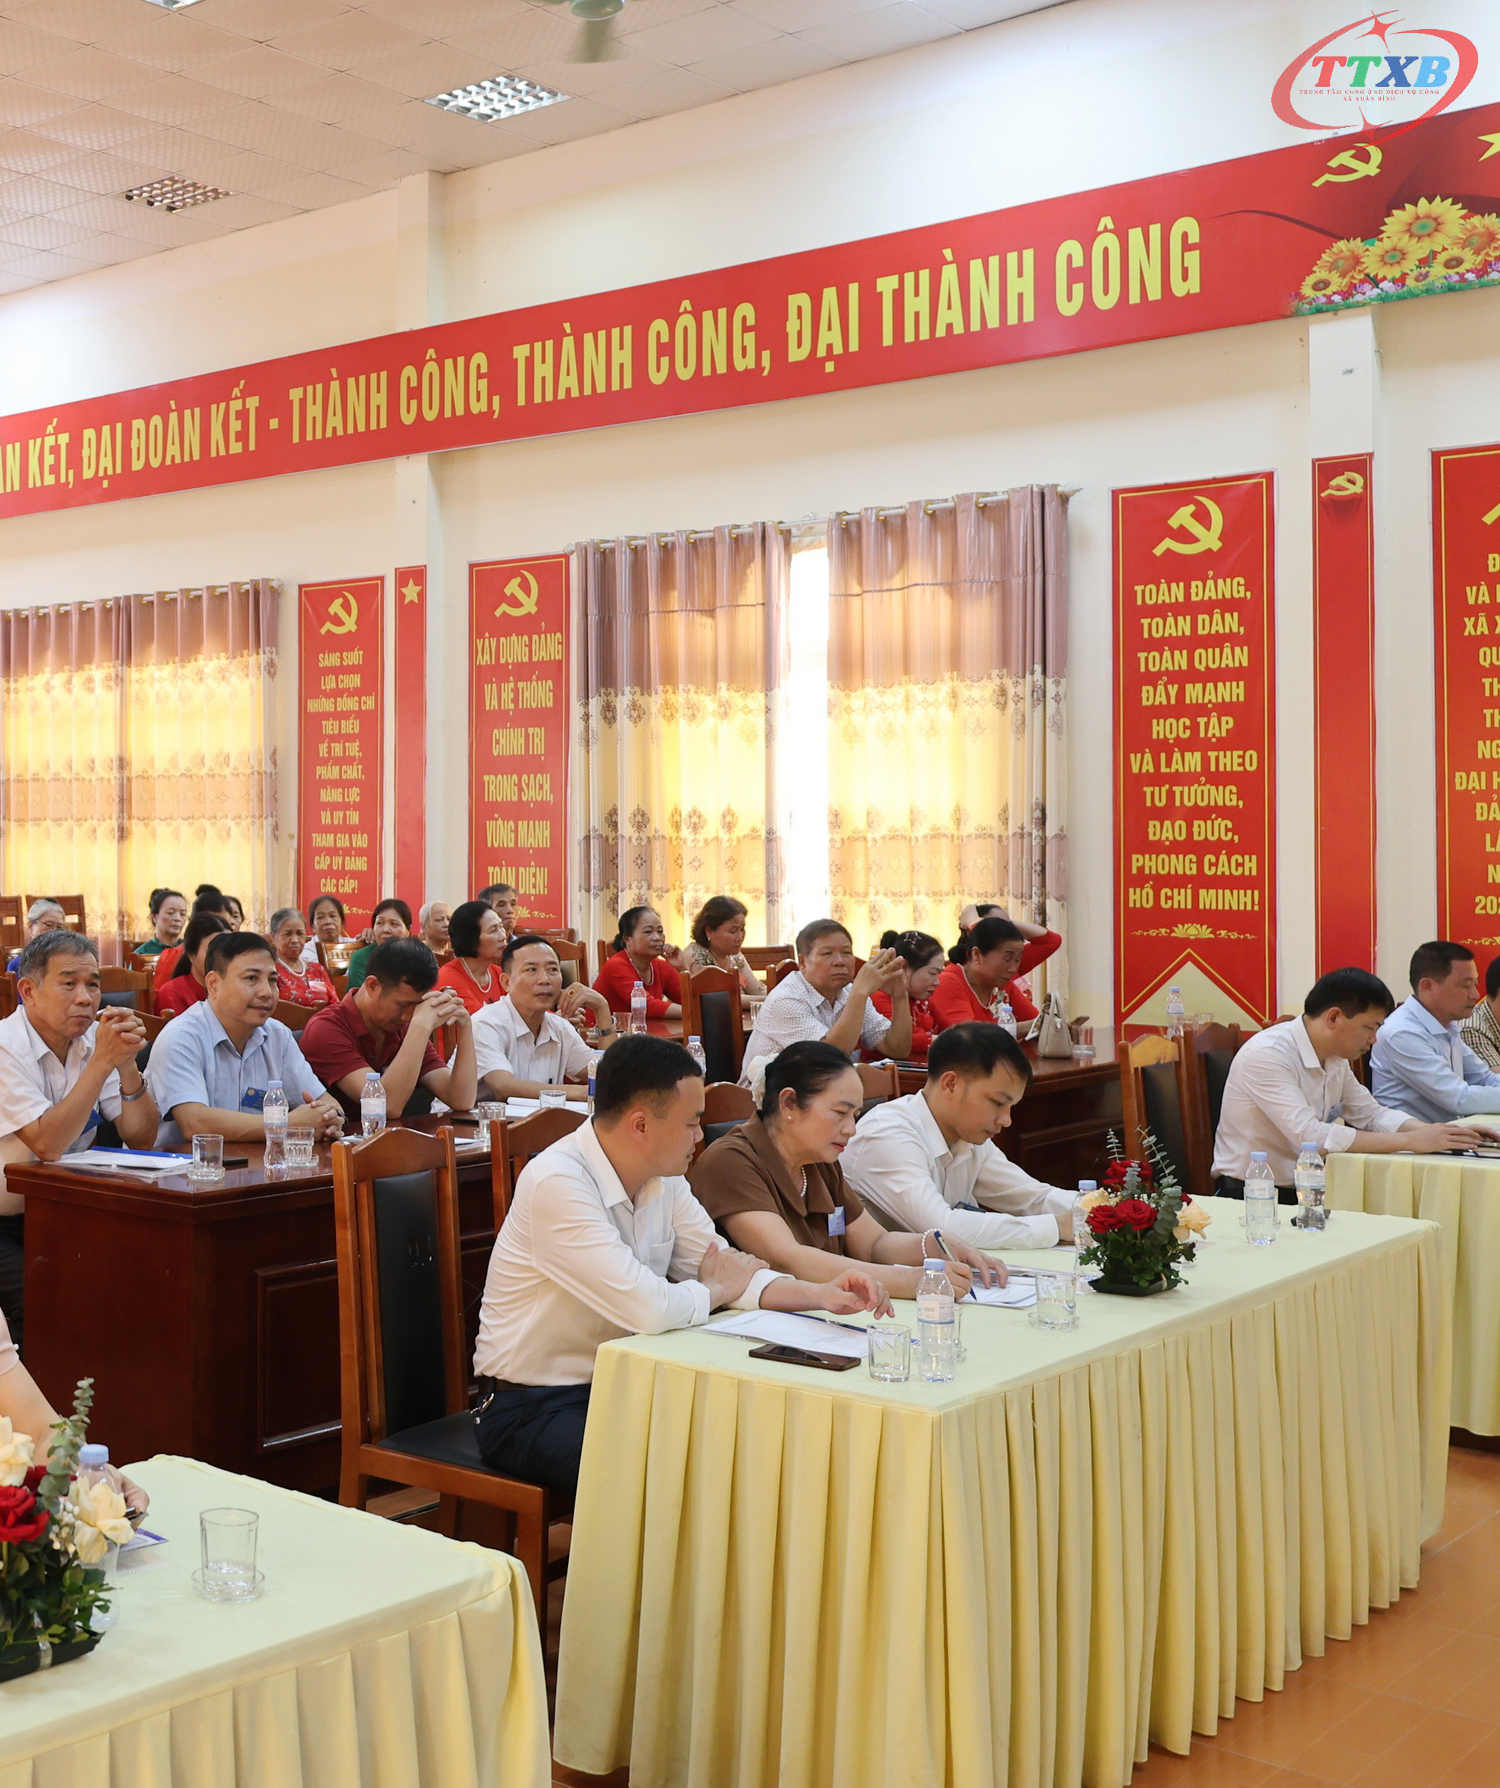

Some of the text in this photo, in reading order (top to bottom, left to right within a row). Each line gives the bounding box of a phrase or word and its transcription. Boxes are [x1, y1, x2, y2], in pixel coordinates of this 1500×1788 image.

[28, 417, 75, 489] KẾT,
[81, 422, 122, 489] ĐẠI
[130, 400, 201, 472] ĐOÀN
[210, 379, 260, 458] KẾT
[288, 367, 388, 444] THÀNH
[399, 348, 500, 426] CÔNG,
[512, 322, 633, 407] THÀNH
[647, 298, 771, 386] CÔNG,
[785, 281, 860, 374] ĐẠI
[875, 247, 1035, 347] THÀNH
[1055, 215, 1201, 318] CÔNG
[1134, 570, 1251, 605] TOÀN ĐẢNG,
[1465, 581, 1491, 605] VÀ
[1141, 608, 1245, 638] TOÀN DÂN,
[1463, 612, 1489, 636] XÃ
[318, 645, 364, 668] SÁNG SUỐT
[476, 621, 562, 669] XÂY DỰNG ĐẢNG
[1137, 642, 1249, 673] TOÀN QUÂN
[321, 673, 361, 692] LỰA CHỌN
[484, 670, 553, 716] VÀ HỆ THỐNG
[1141, 676, 1245, 708] ĐẨY MẠNH
[307, 694, 335, 712] NHỮNG
[360, 692, 375, 711] CHÍ
[321, 713, 359, 735] TIÊU BIỂU
[1152, 712, 1234, 743] HỌC TẬP
[330, 739, 343, 757] TRÍ
[345, 739, 362, 759] TUỆ,
[492, 722, 545, 761] CHÍNH TRỊ
[316, 759, 365, 780] PHẨM CHẤT,
[1129, 747, 1258, 774] VÀ LÀM THEO
[320, 785, 360, 805] NĂNG LỰC
[483, 773, 554, 808] TRONG SẠCH,
[1143, 776, 1244, 809] TƯ TƯỞNG,
[1455, 771, 1487, 794] ĐẠI
[320, 807, 359, 825] VÀ UY TÍN
[1148, 813, 1239, 845] ĐẠO ĐỨC,
[311, 830, 368, 848] THAM GIA VÀO
[486, 813, 550, 854] VỮNG MẠNH
[314, 850, 368, 871] CẤP UỶ ĐẢNG
[1131, 850, 1257, 876] PHONG CÁCH
[320, 874, 358, 894] CÁC CẤP!
[487, 861, 548, 901] TOÀN DIỆN!
[1128, 881, 1260, 911] HỒ CHÍ MINH!
